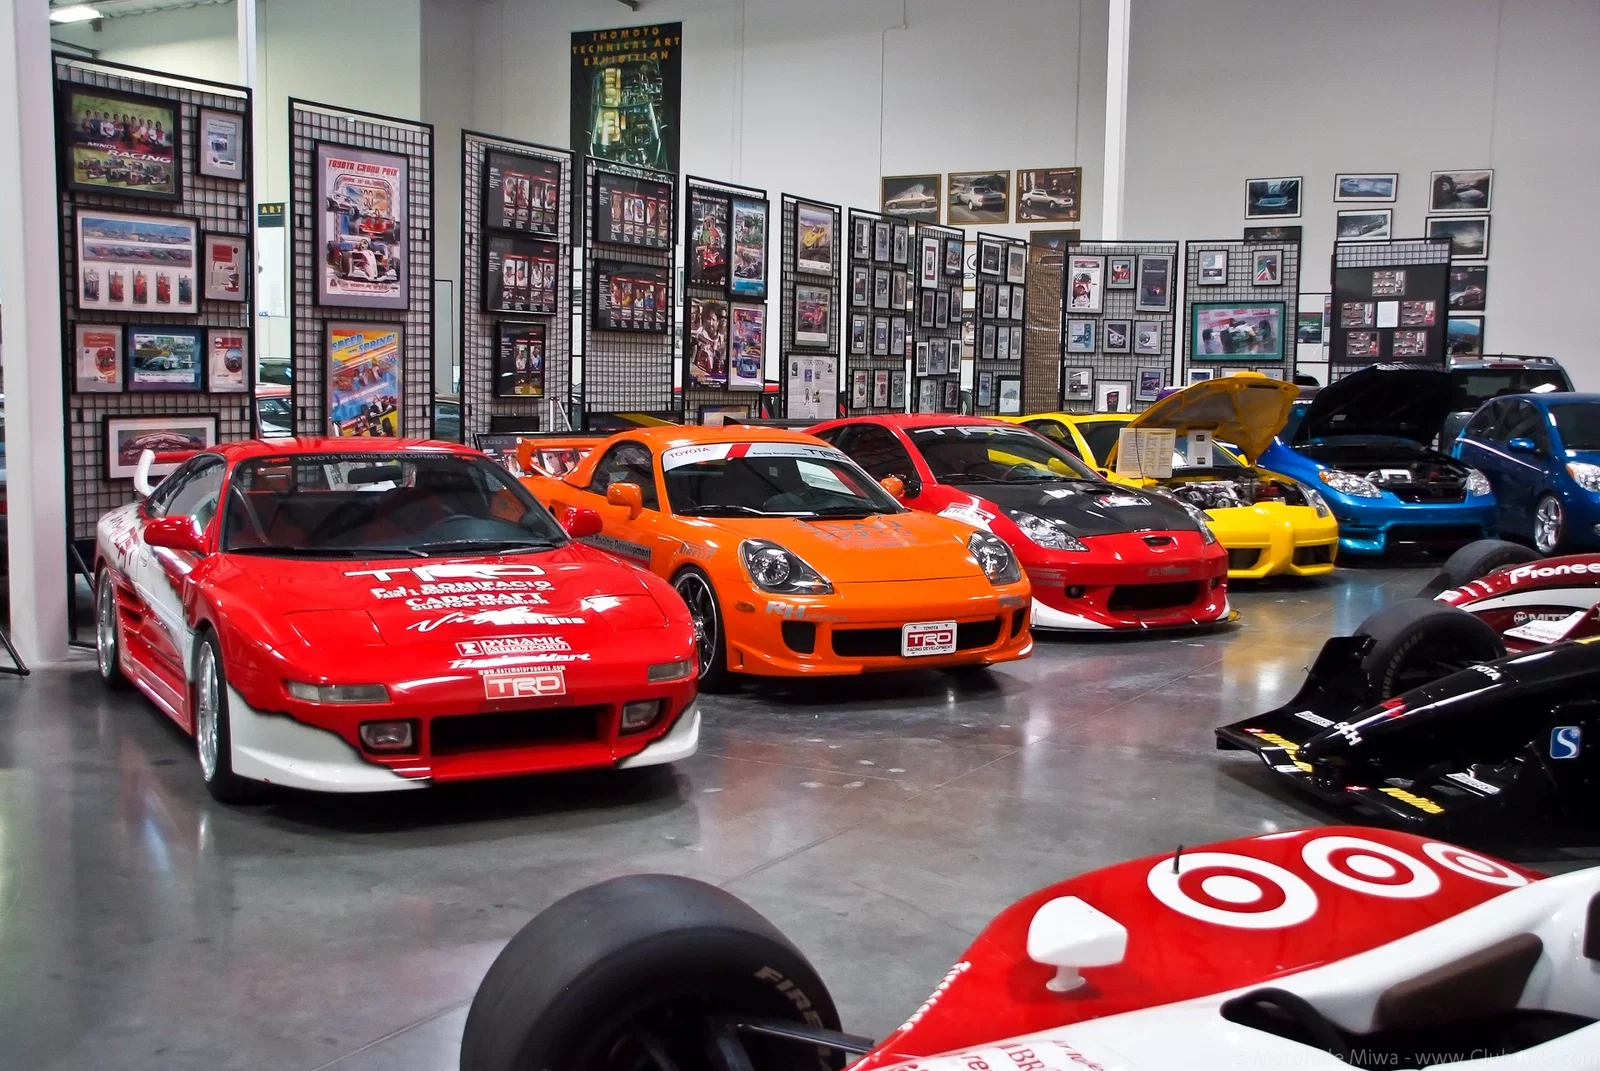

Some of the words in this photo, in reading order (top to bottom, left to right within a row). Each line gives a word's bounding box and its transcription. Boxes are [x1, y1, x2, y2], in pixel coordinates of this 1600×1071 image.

[593, 27, 660, 41] INOMOTO
[572, 40, 648, 55] TECHNICAL
[654, 37, 680, 47] ART
[583, 51, 669, 66] EXHIBITION
[107, 149, 171, 164] RACING
[328, 159, 355, 170] TOYOTA
[356, 163, 380, 174] GRAND
[382, 168, 398, 177] PRIX
[261, 205, 282, 214] ART
[331, 334, 363, 349] SPEED
[359, 332, 396, 352] SPRING!
[668, 447, 711, 458] TOYOTA
[595, 534, 615, 550] Racing
[615, 539, 652, 559] Development
[343, 563, 546, 582] TRD
[405, 592, 545, 606] CARCRAFT
[765, 600, 806, 620] RH
[480, 636, 566, 647] DYNAMIC
[909, 632, 951, 646] TRD
[488, 675, 561, 696] TRD
